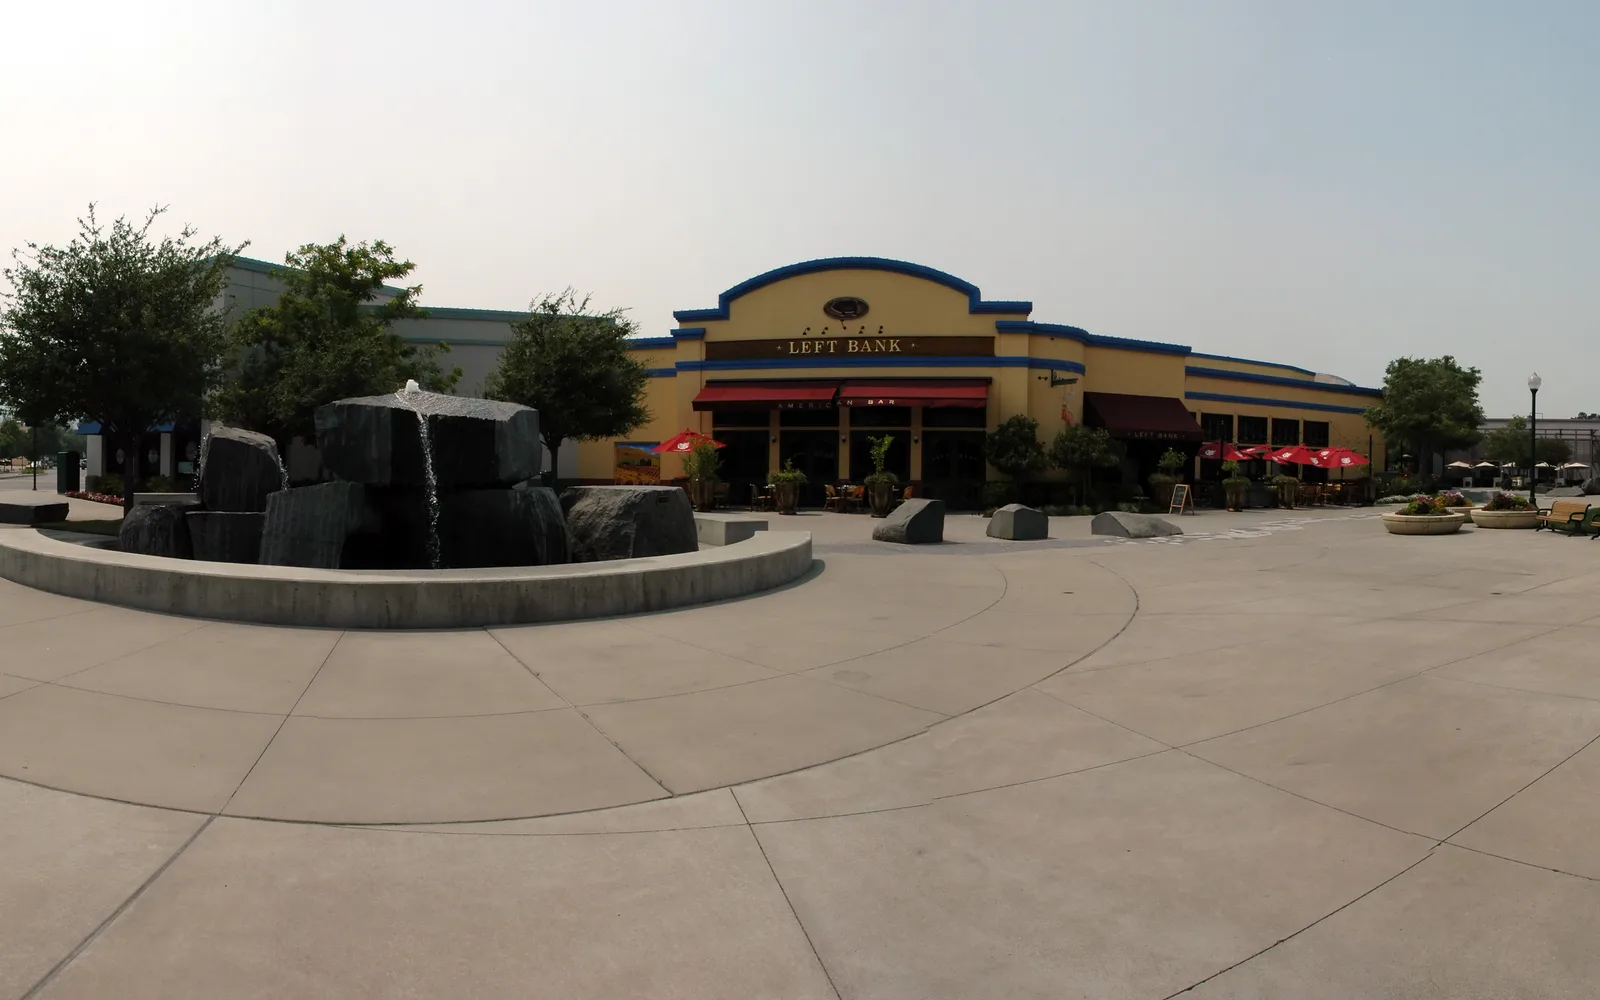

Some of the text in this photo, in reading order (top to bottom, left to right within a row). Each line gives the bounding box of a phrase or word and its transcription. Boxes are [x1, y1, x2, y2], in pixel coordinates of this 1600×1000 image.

[788, 339, 902, 354] LEFT BANK
[777, 400, 853, 409] AMERICAN
